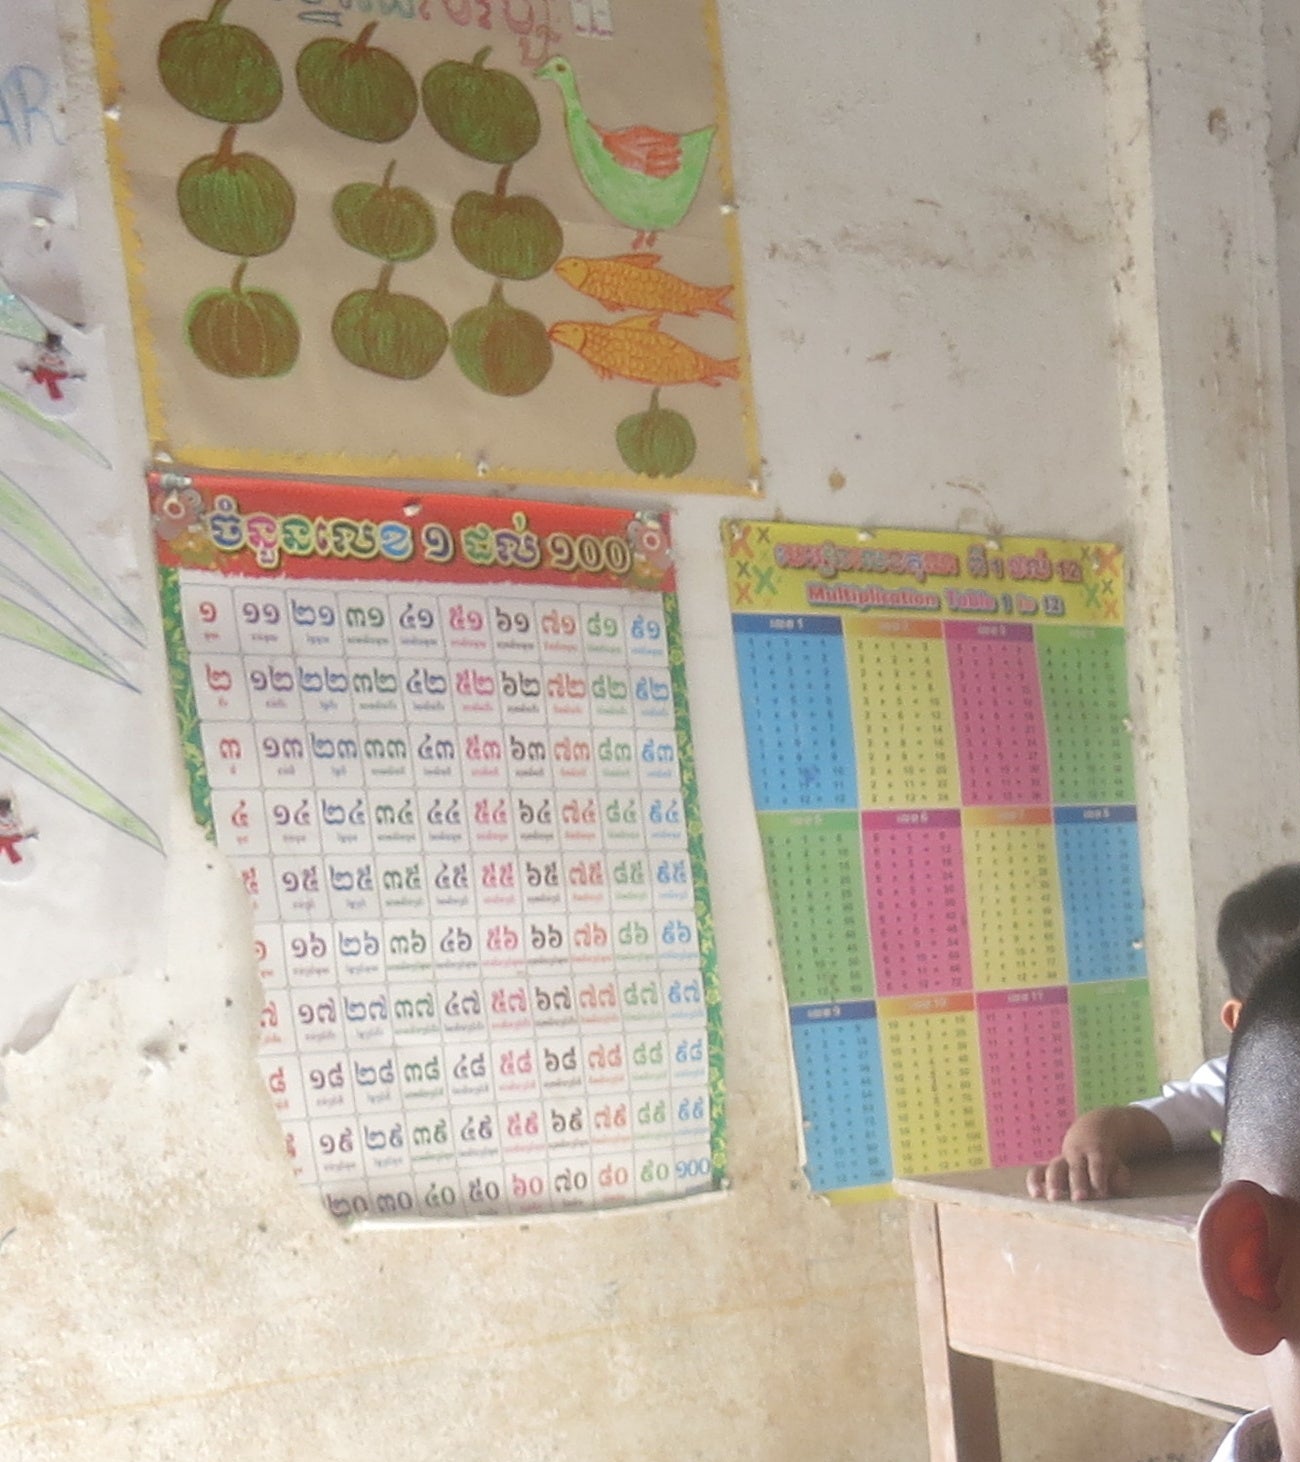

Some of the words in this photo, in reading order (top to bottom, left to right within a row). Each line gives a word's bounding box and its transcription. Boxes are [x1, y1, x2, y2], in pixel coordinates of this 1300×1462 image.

[208, 495, 413, 568] ចំនួនលេខ
[423, 524, 453, 561] ១
[462, 513, 540, 565] ដល់
[548, 534, 631, 574] ១០០
[199, 602, 217, 623] ១
[243, 603, 280, 624] ១១
[291, 599, 335, 626] ២១
[346, 607, 384, 627] ៣១
[399, 603, 434, 629] ៤១
[495, 607, 529, 633] ៦១
[807, 583, 940, 611] Multiplication
[945, 589, 998, 613] Table
[1002, 594, 1013, 613] 1
[1042, 595, 1065, 615] 12
[205, 664, 232, 691] ២
[250, 665, 294, 692] ១២
[298, 666, 349, 693] ២២
[352, 668, 397, 693] ៣២
[406, 669, 447, 694] ៤២
[501, 671, 540, 697] ៦២
[220, 738, 241, 758] ៣
[263, 738, 303, 758] ១៣
[310, 732, 357, 759] ២៣
[364, 739, 406, 758] ៣៣
[418, 733, 454, 759] ៤៣
[510, 735, 545, 760] ៦៣
[231, 800, 248, 827] ៤
[273, 799, 310, 825] ១៤
[322, 799, 365, 825] ២៤
[376, 799, 413, 824] ៣៤
[427, 799, 460, 824] ៤៤
[519, 799, 551, 823] ៦៤
[282, 866, 318, 892] ១៥
[330, 865, 373, 891] ២៥
[383, 864, 421, 890] ៣៥
[435, 863, 468, 889] ៤៥
[526, 862, 558, 886] ៦៥
[291, 932, 326, 958] ១៦
[339, 930, 379, 956] ២៦
[391, 929, 426, 954] ៣៦
[440, 927, 472, 952] ៤៦
[531, 924, 562, 949] ៦៦
[298, 998, 336, 1024] ១៧
[344, 995, 387, 1022] ២៧
[395, 993, 434, 1018] ៣៧
[445, 990, 480, 1016] ៤៧
[535, 986, 571, 1011] ៦៧
[269, 1067, 286, 1093] ៨
[310, 1062, 344, 1089] ១៨
[354, 1059, 394, 1086] ២៨
[404, 1056, 440, 1082] ៣៨
[453, 1053, 485, 1079] ៤៨
[545, 1046, 577, 1072] ៦៨
[320, 1127, 353, 1154] ១៩
[364, 1123, 403, 1150] ២៩
[414, 1119, 447, 1145] ៣៩
[461, 1115, 492, 1141] ៤៩
[551, 1107, 582, 1132] ៦៩
[378, 1190, 412, 1212] ៣០
[425, 1183, 455, 1207] ៤០
[470, 1178, 499, 1202] ៥០
[555, 1168, 587, 1193] ៧០
